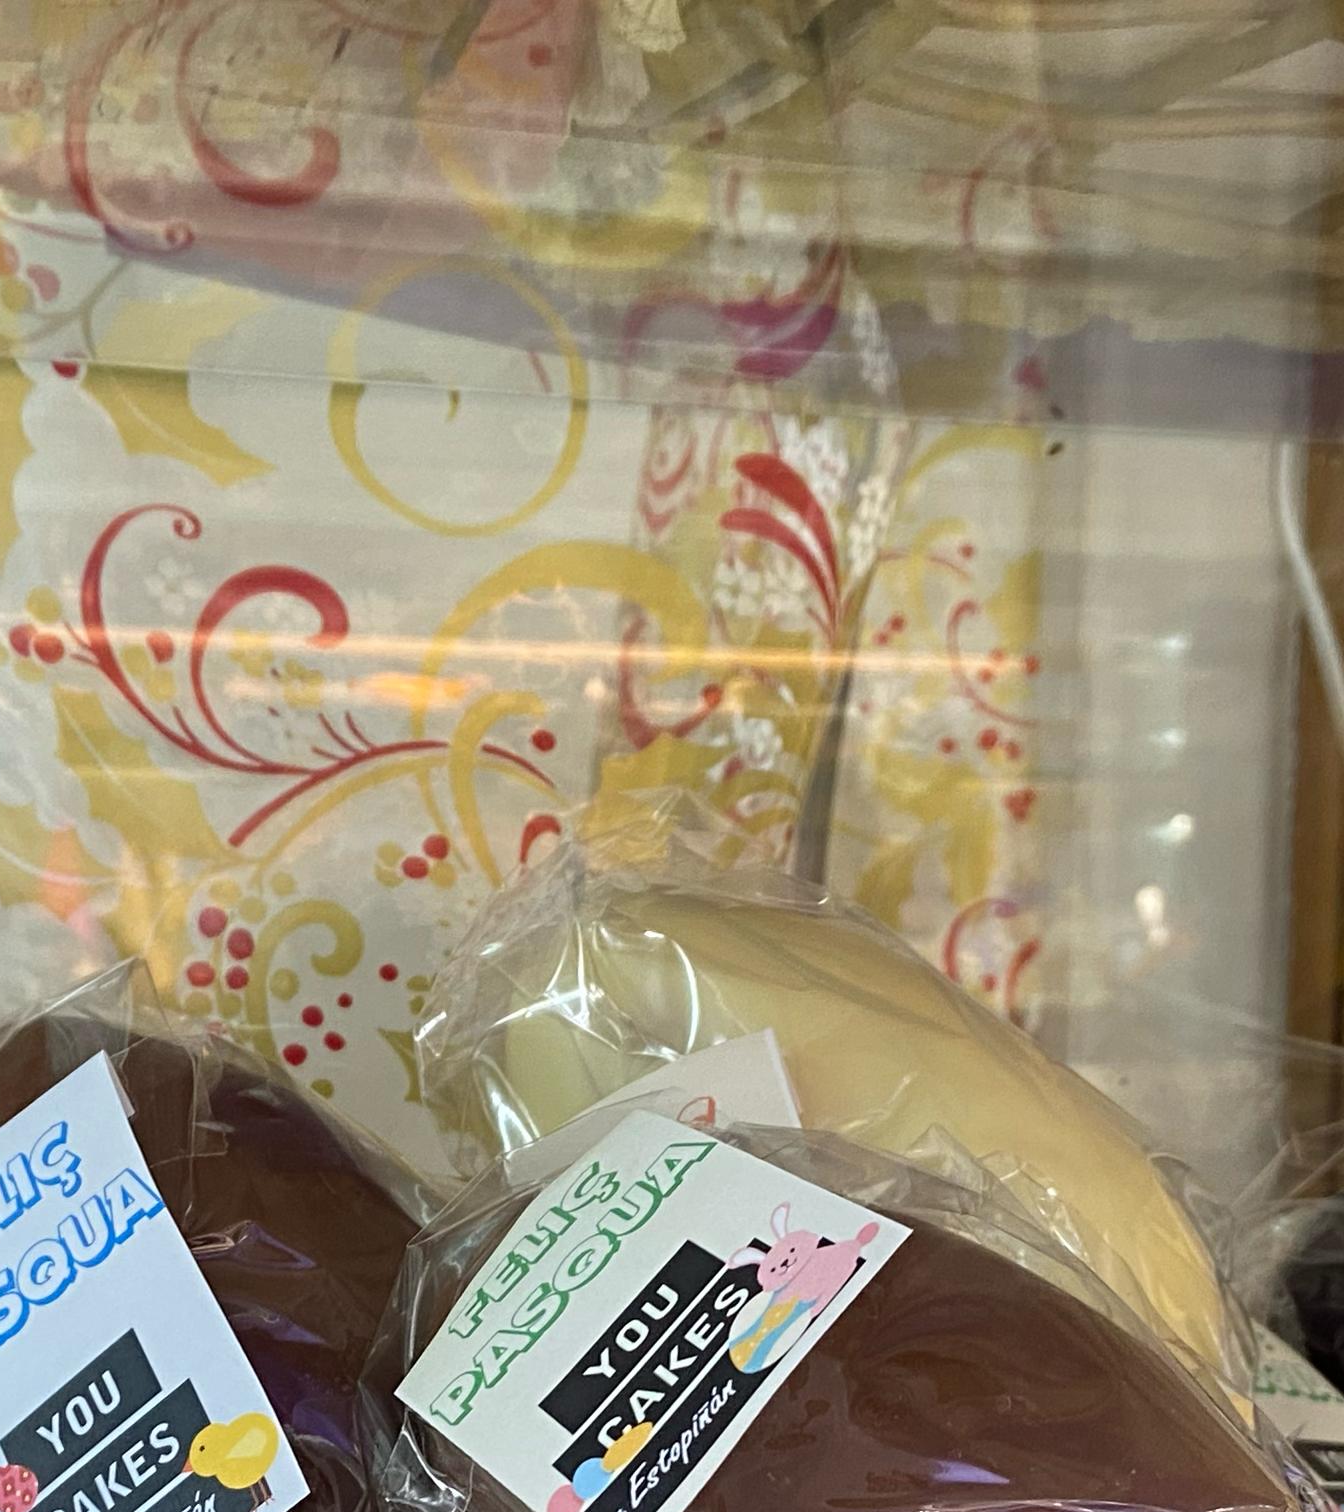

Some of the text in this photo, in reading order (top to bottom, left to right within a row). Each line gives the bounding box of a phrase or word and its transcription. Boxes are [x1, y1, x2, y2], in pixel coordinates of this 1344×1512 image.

[430, 1141, 718, 1426] PASQUA
[449, 1160, 622, 1340] FELIÇ
[582, 1283, 680, 1383] YOU
[597, 1282, 749, 1448] CAKES
[37, 1370, 122, 1455] YOU
[629, 1378, 737, 1508] Estopiñán
